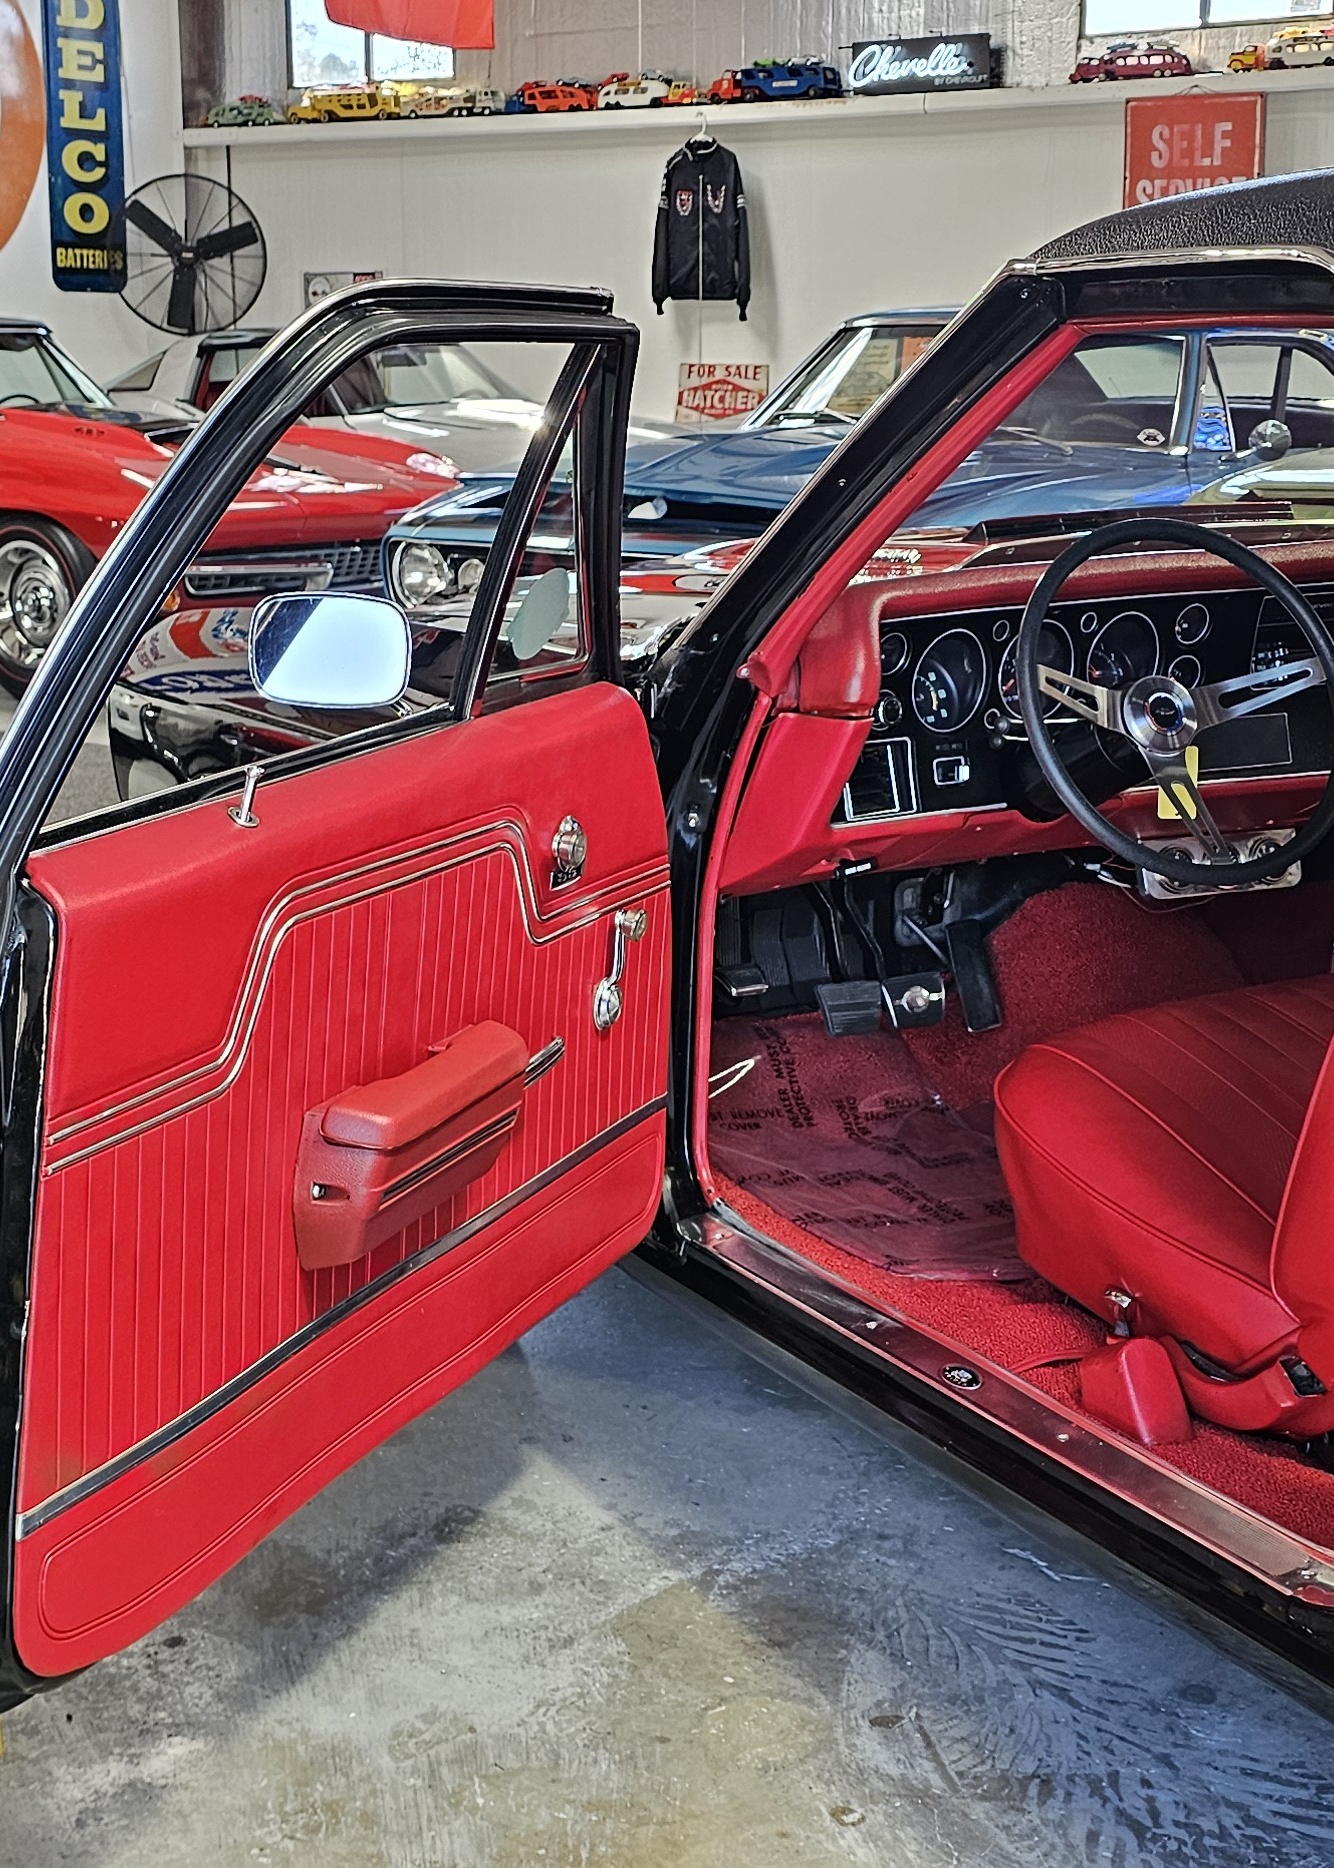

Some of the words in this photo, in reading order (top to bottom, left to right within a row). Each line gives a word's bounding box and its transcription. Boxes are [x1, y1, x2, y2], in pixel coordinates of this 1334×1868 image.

[848, 42, 969, 88] Chevelle
[55, 0, 110, 234] DELCO
[1150, 122, 1233, 168] SELF
[55, 246, 123, 270] BATTERIES
[687, 365, 716, 379] FOR
[725, 365, 762, 380] SALE
[682, 389, 760, 410] HATCHER
[730, 1107, 785, 1121] REMOVE
[777, 1088, 805, 1128] DEALER
